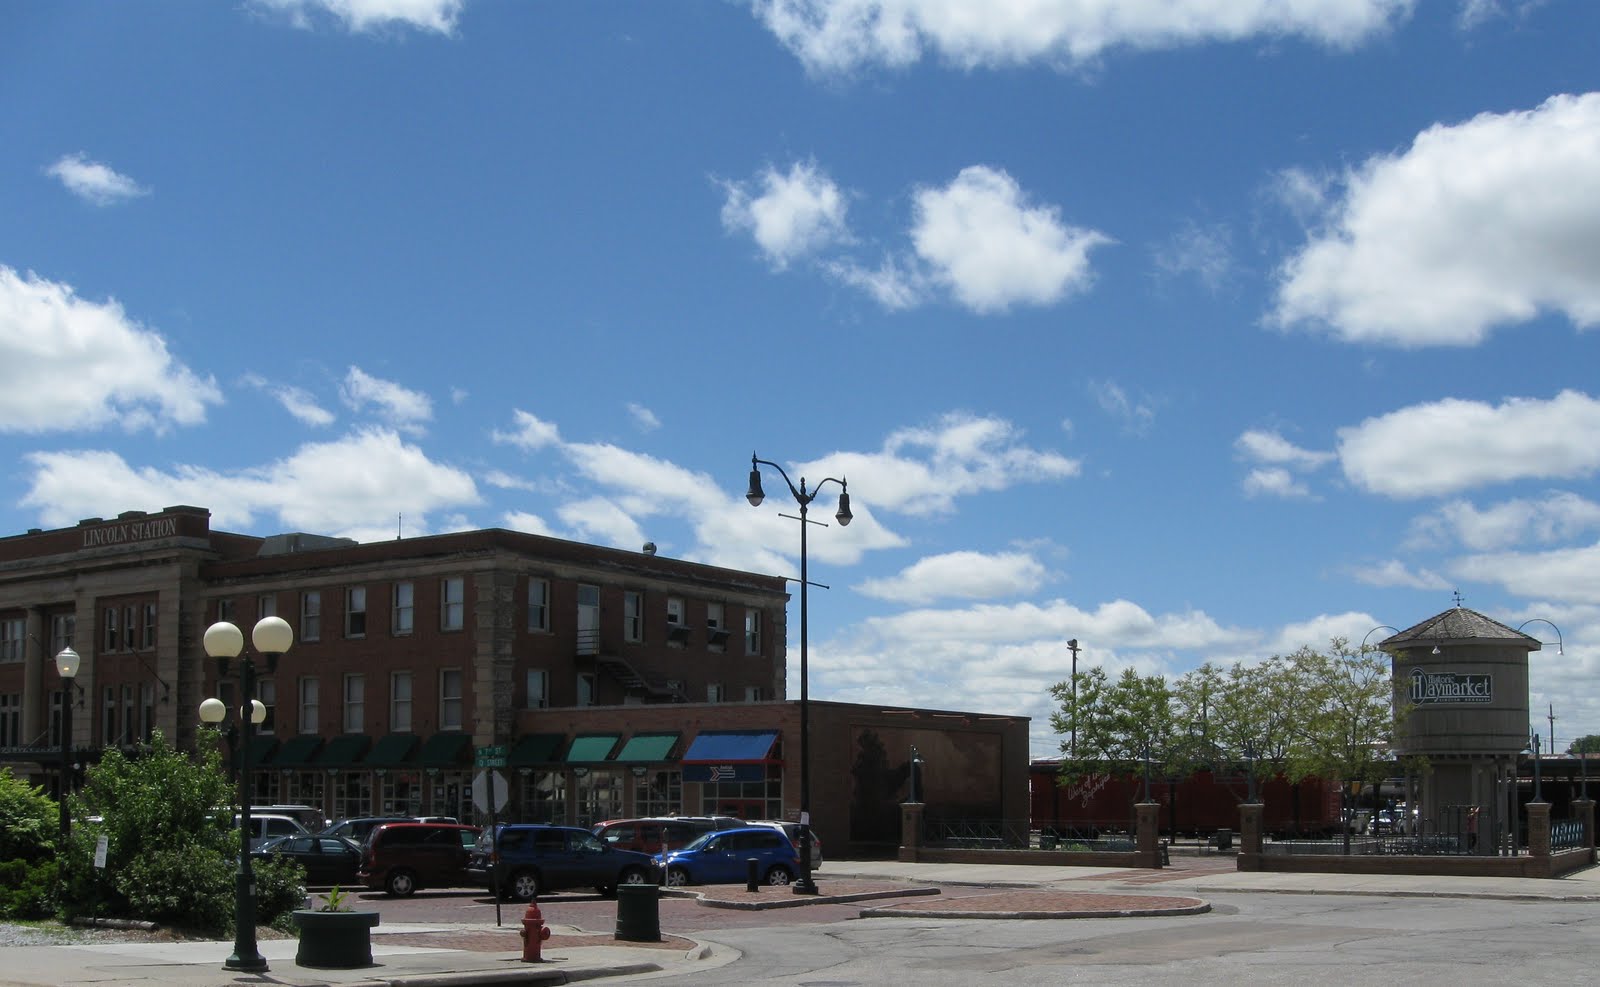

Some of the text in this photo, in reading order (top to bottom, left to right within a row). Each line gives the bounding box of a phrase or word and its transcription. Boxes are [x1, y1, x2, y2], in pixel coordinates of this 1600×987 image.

[83, 518, 177, 547] LINCOLN STATION
[1412, 676, 1491, 703] Haymarket
[1428, 675, 1455, 684] Historic
